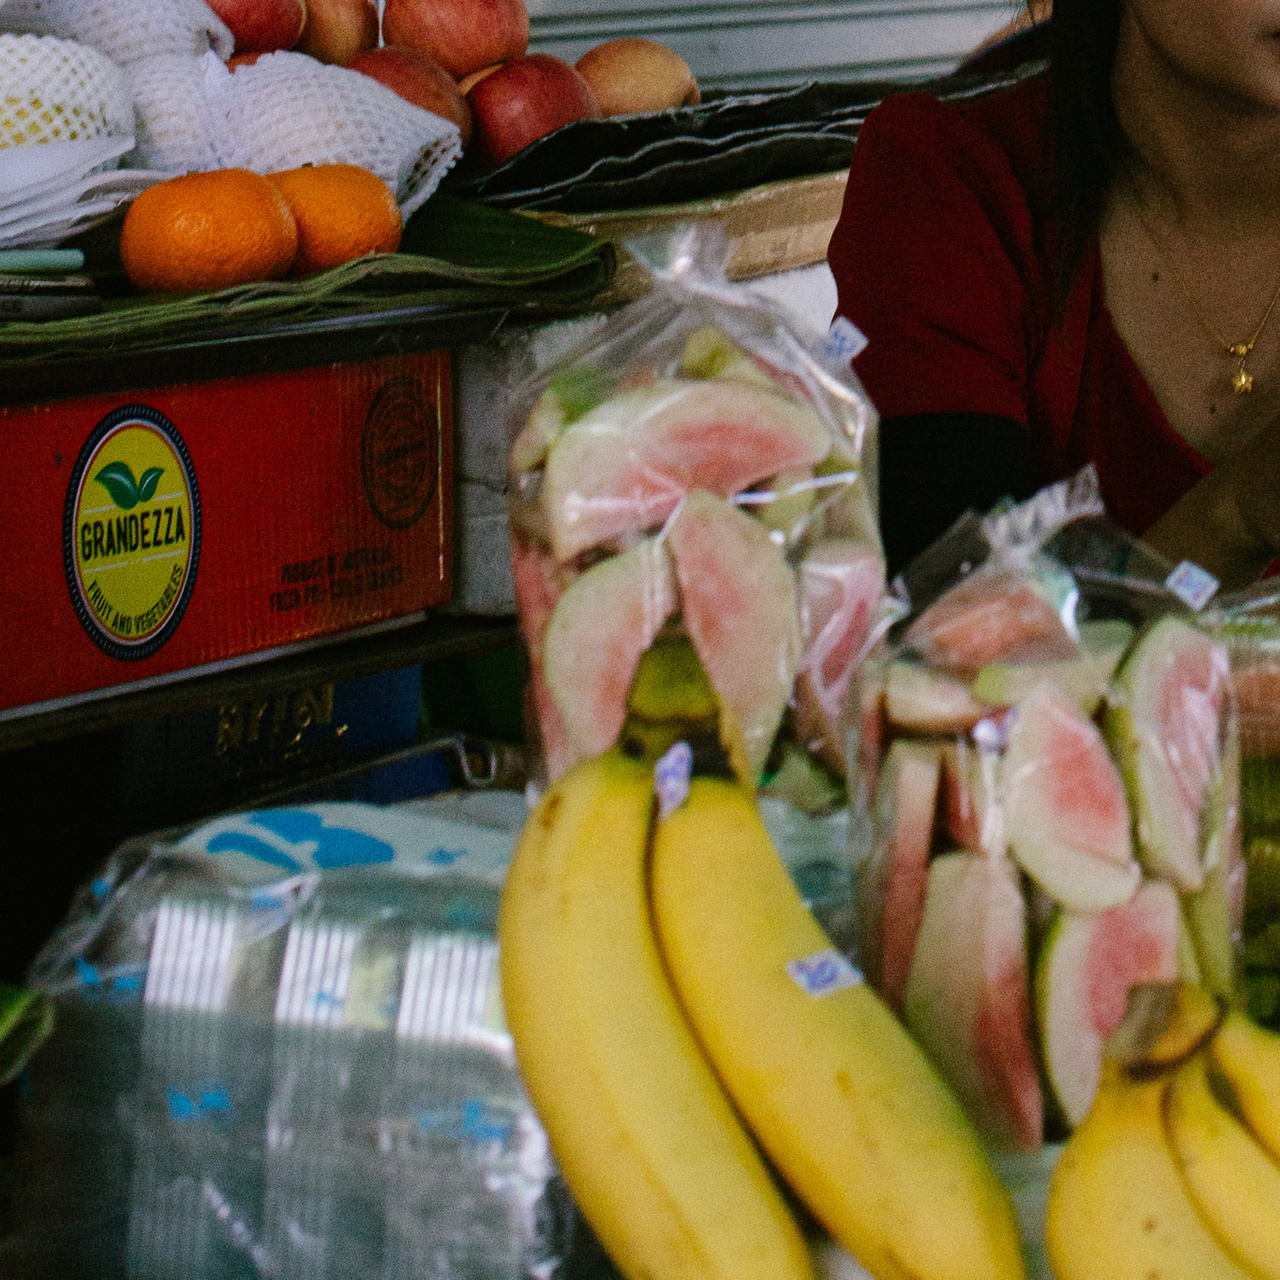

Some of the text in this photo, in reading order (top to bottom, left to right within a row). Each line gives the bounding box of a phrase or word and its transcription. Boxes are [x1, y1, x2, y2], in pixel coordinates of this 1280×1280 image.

[81, 506, 185, 562] GRANDEZZA
[87, 579, 113, 622] FRUIT
[112, 611, 132, 634] AND
